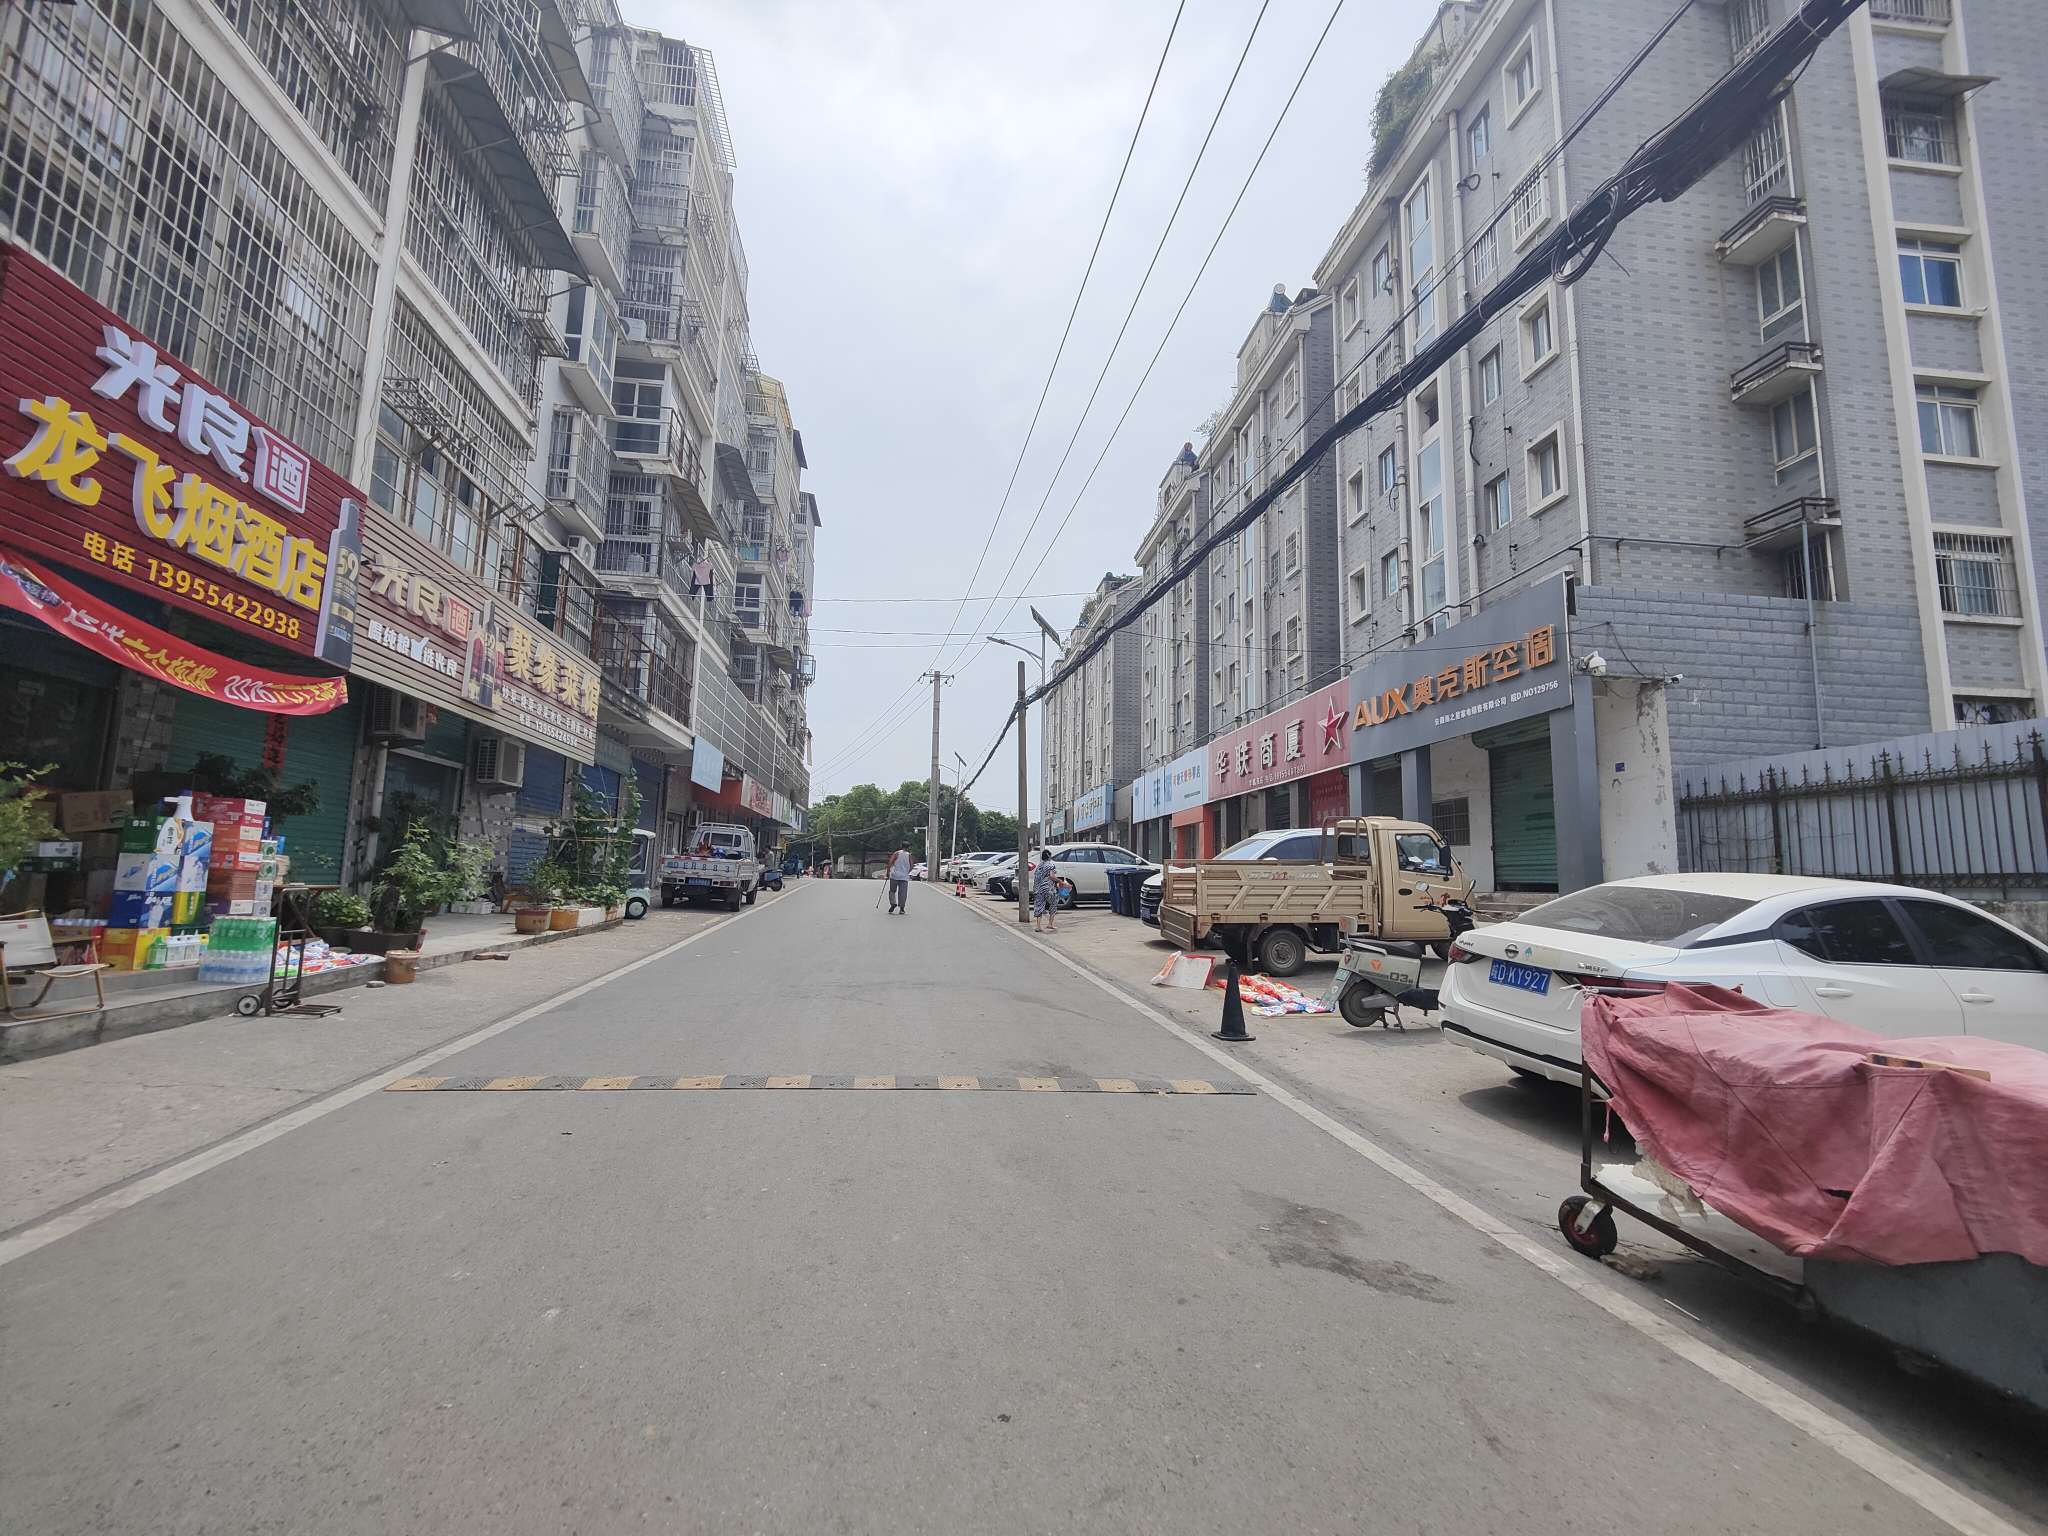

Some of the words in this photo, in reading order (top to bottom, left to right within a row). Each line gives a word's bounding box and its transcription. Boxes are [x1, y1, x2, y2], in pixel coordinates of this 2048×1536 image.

[92, 326, 311, 512] 光良酒
[3, 396, 327, 611] 龙飞烟酒店
[83, 531, 135, 573] 电话
[148, 558, 300, 639] 13955422938
[370, 553, 470, 642] 光良酒
[1353, 683, 1411, 731] AUX
[1413, 624, 1554, 711] 奥克斯空调
[1215, 719, 1304, 783] 华联商厦
